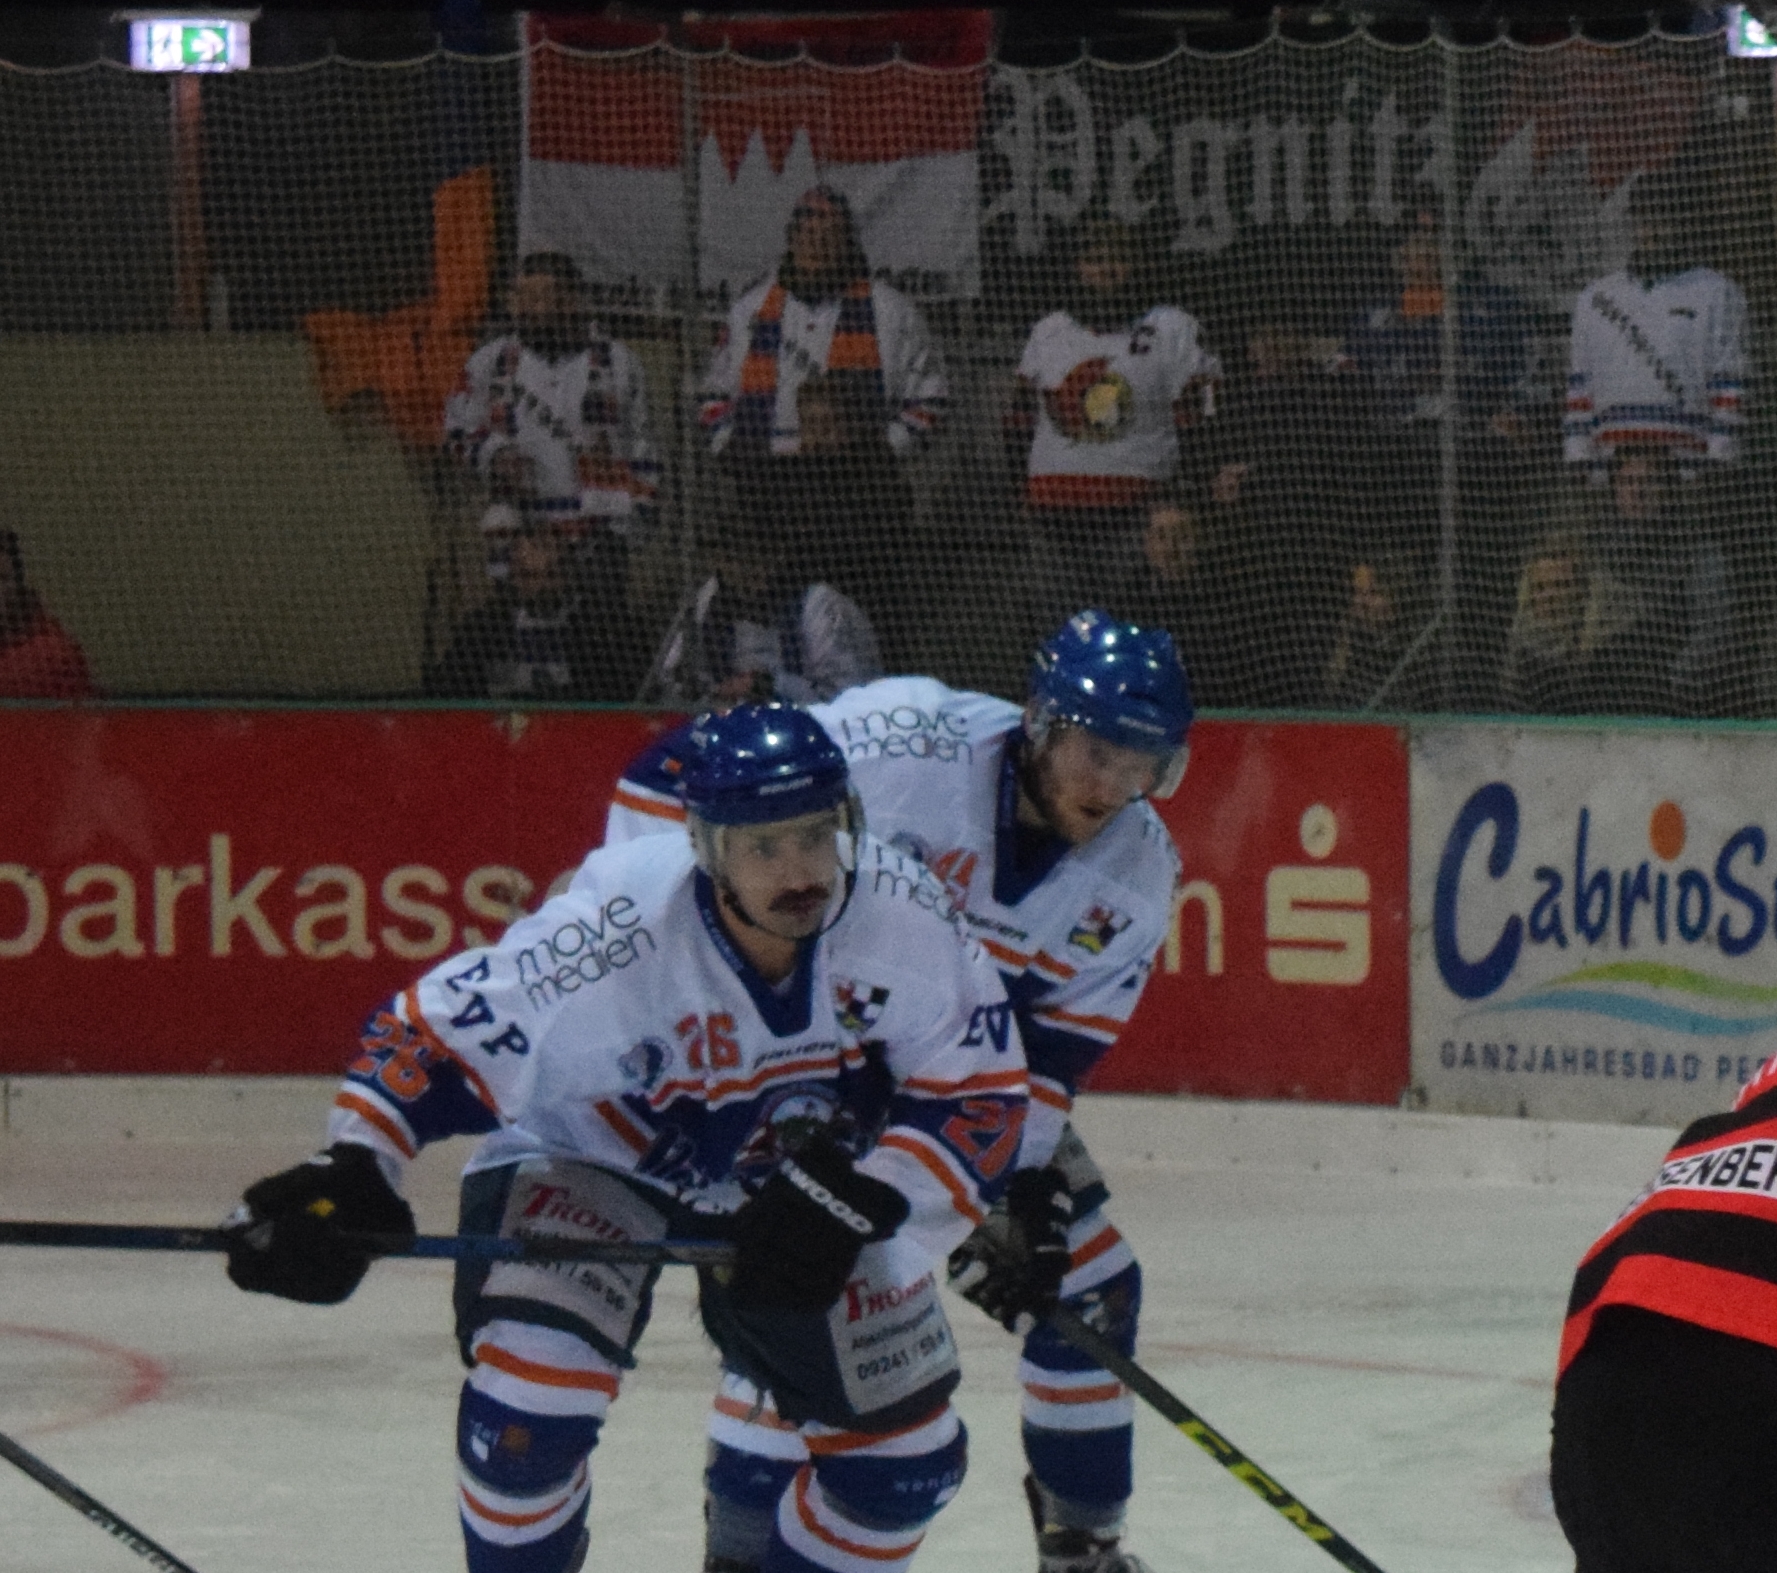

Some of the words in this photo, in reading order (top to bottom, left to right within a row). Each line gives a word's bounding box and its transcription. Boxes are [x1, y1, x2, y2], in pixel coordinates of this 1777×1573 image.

[0, 834, 575, 962] parkass
[515, 895, 642, 983] move
[525, 925, 658, 1012] medien
[676, 1013, 741, 1071] 26
[1440, 1040, 1702, 1084] GANZJAHRESBAD
[1716, 1055, 1767, 1084] PE
